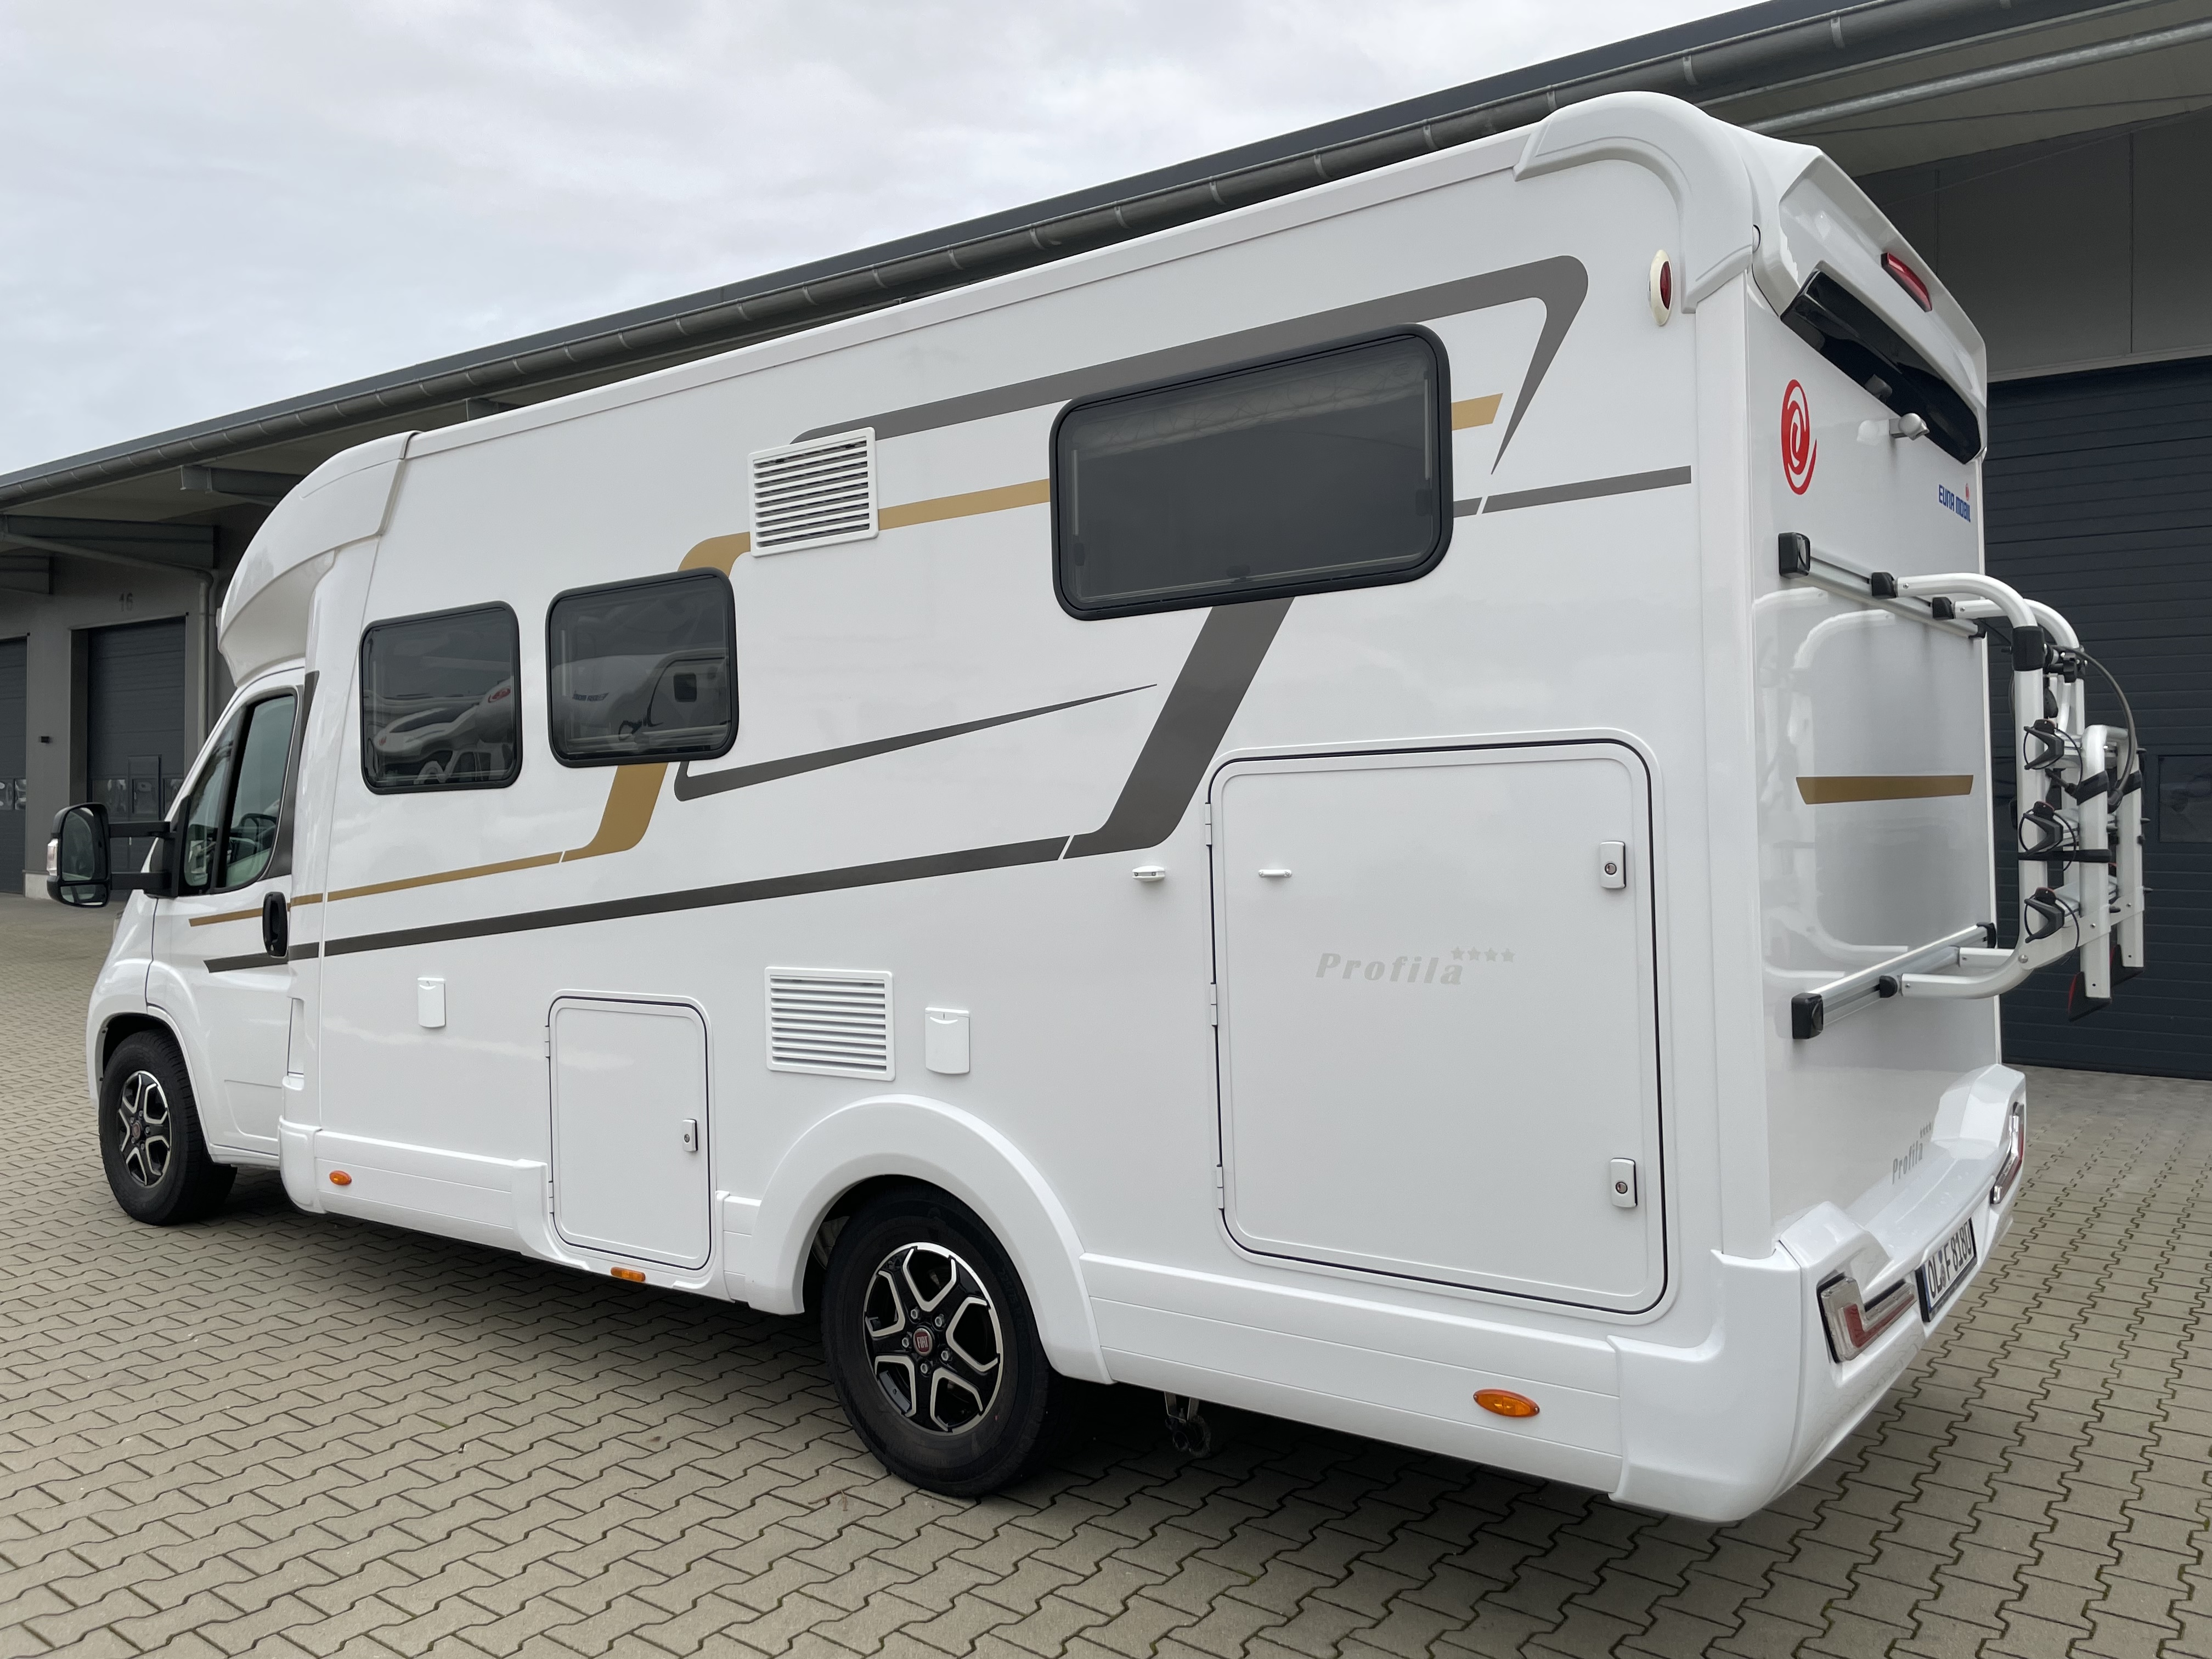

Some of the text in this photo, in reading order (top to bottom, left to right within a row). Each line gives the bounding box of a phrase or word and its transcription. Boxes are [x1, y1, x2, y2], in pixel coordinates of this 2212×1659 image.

[1939, 484, 1954, 512] EURA
[119, 592, 133, 612] 16
[1315, 952, 1464, 985] Profila
[1892, 1140, 1923, 1185] Profila
[1928, 1255, 1943, 1298] OL
[1944, 1243, 1950, 1281] F
[916, 1335, 928, 1348] FIAT
